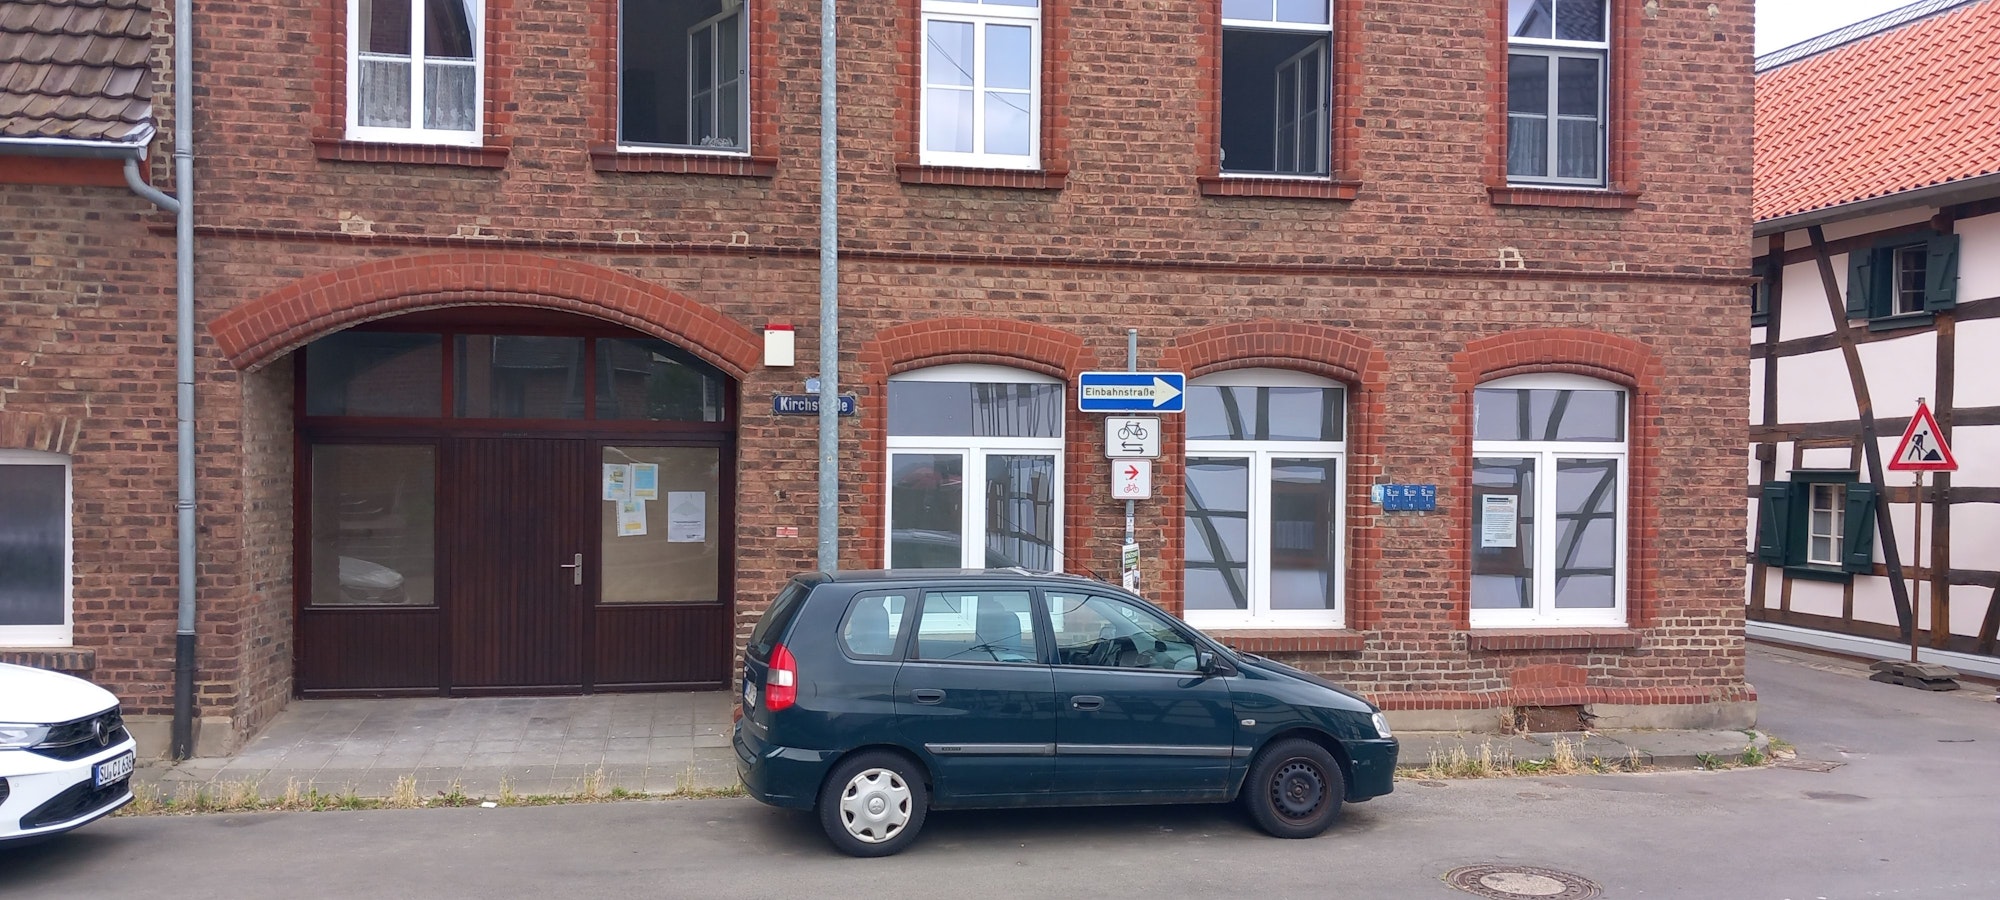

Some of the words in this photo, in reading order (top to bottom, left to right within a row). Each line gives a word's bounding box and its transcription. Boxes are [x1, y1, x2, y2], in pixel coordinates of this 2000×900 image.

[1085, 387, 1155, 396] Einbahnstraße
[780, 396, 848, 412] Kirchse
[100, 764, 109, 782] SU
